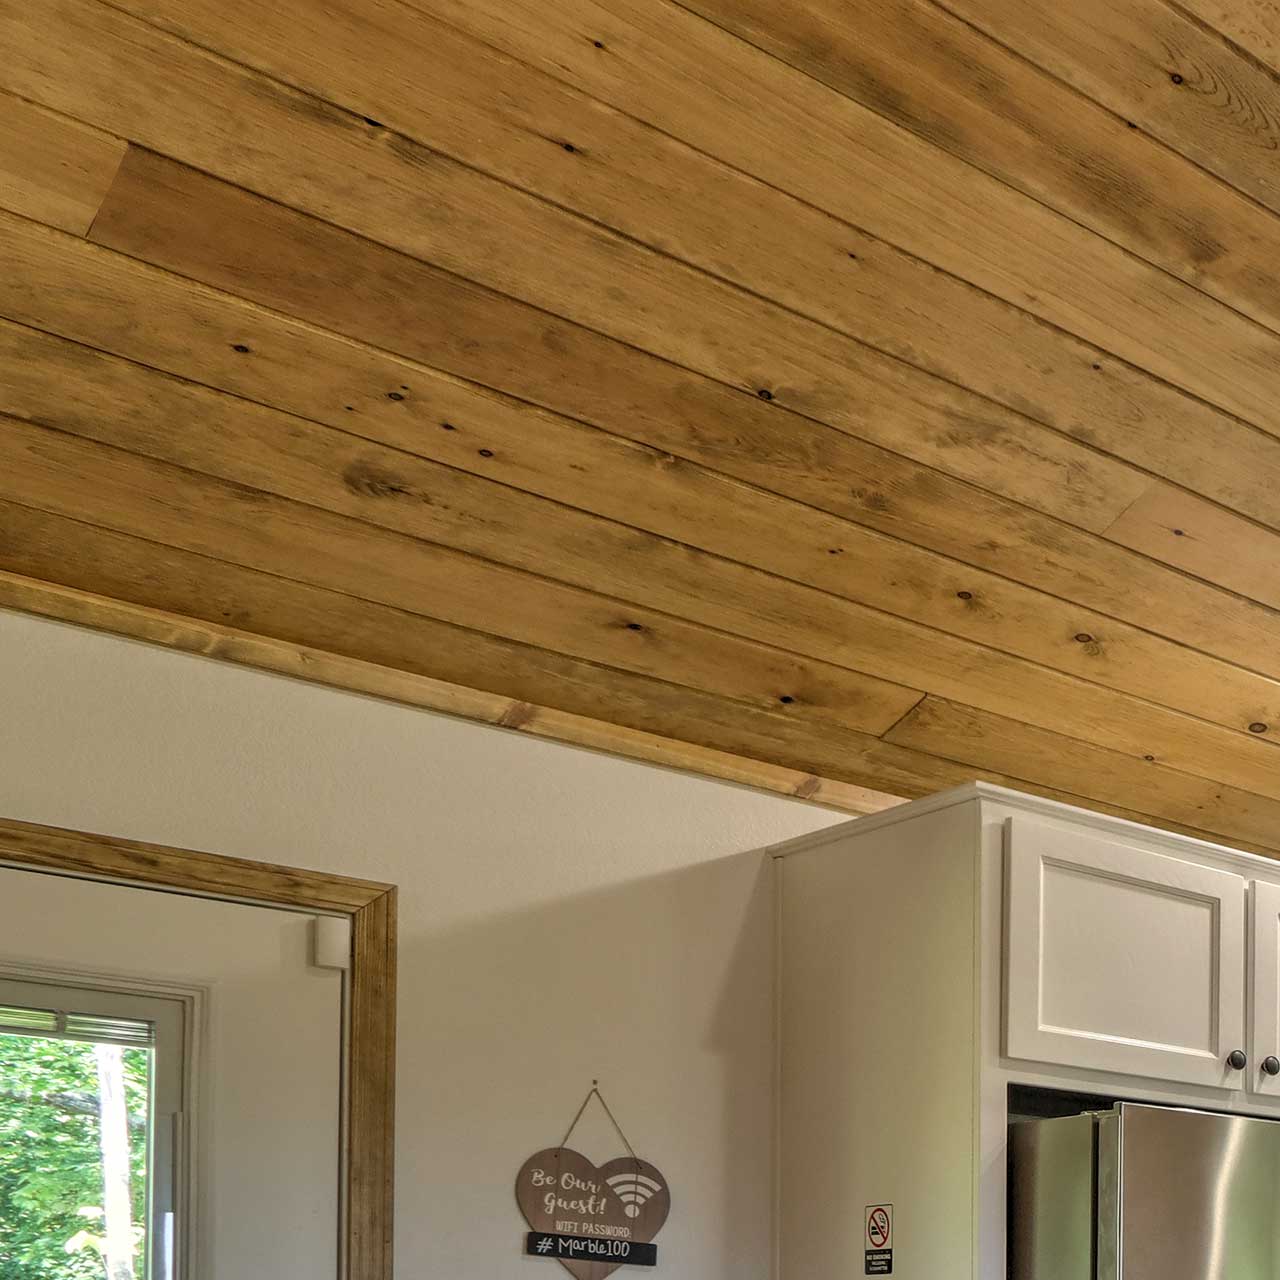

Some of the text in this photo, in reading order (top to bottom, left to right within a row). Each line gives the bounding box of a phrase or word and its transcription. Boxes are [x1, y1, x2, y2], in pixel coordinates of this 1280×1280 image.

[531, 1168, 600, 1194] Be Our
[544, 1192, 607, 1215] Guest!
[555, 1220, 632, 1239] WIFI PASSWORD:
[558, 1238, 630, 1257] Marble100
